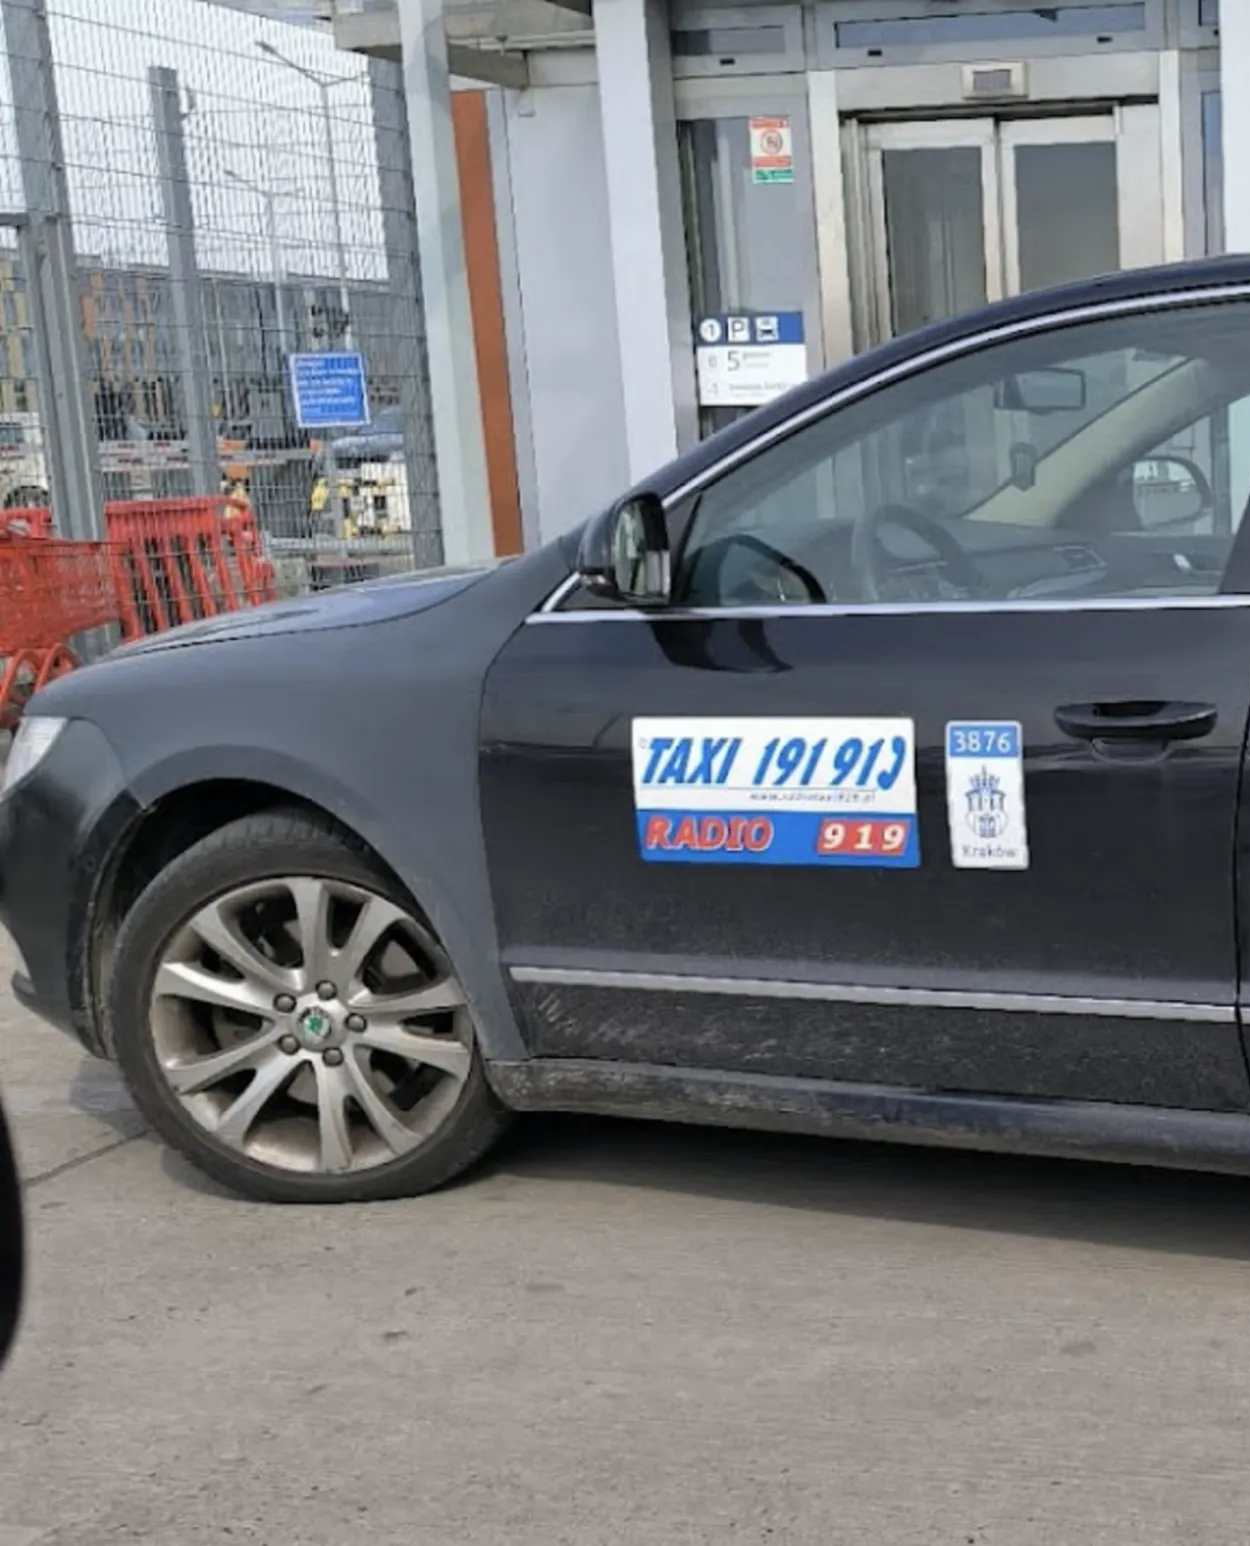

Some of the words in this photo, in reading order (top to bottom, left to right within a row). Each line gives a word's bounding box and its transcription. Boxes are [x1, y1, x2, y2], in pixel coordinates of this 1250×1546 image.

[727, 350, 741, 371] 5
[953, 730, 1011, 753] 3876
[642, 737, 742, 784] TAXI
[645, 816, 774, 852] RADIO
[822, 823, 906, 851] 919
